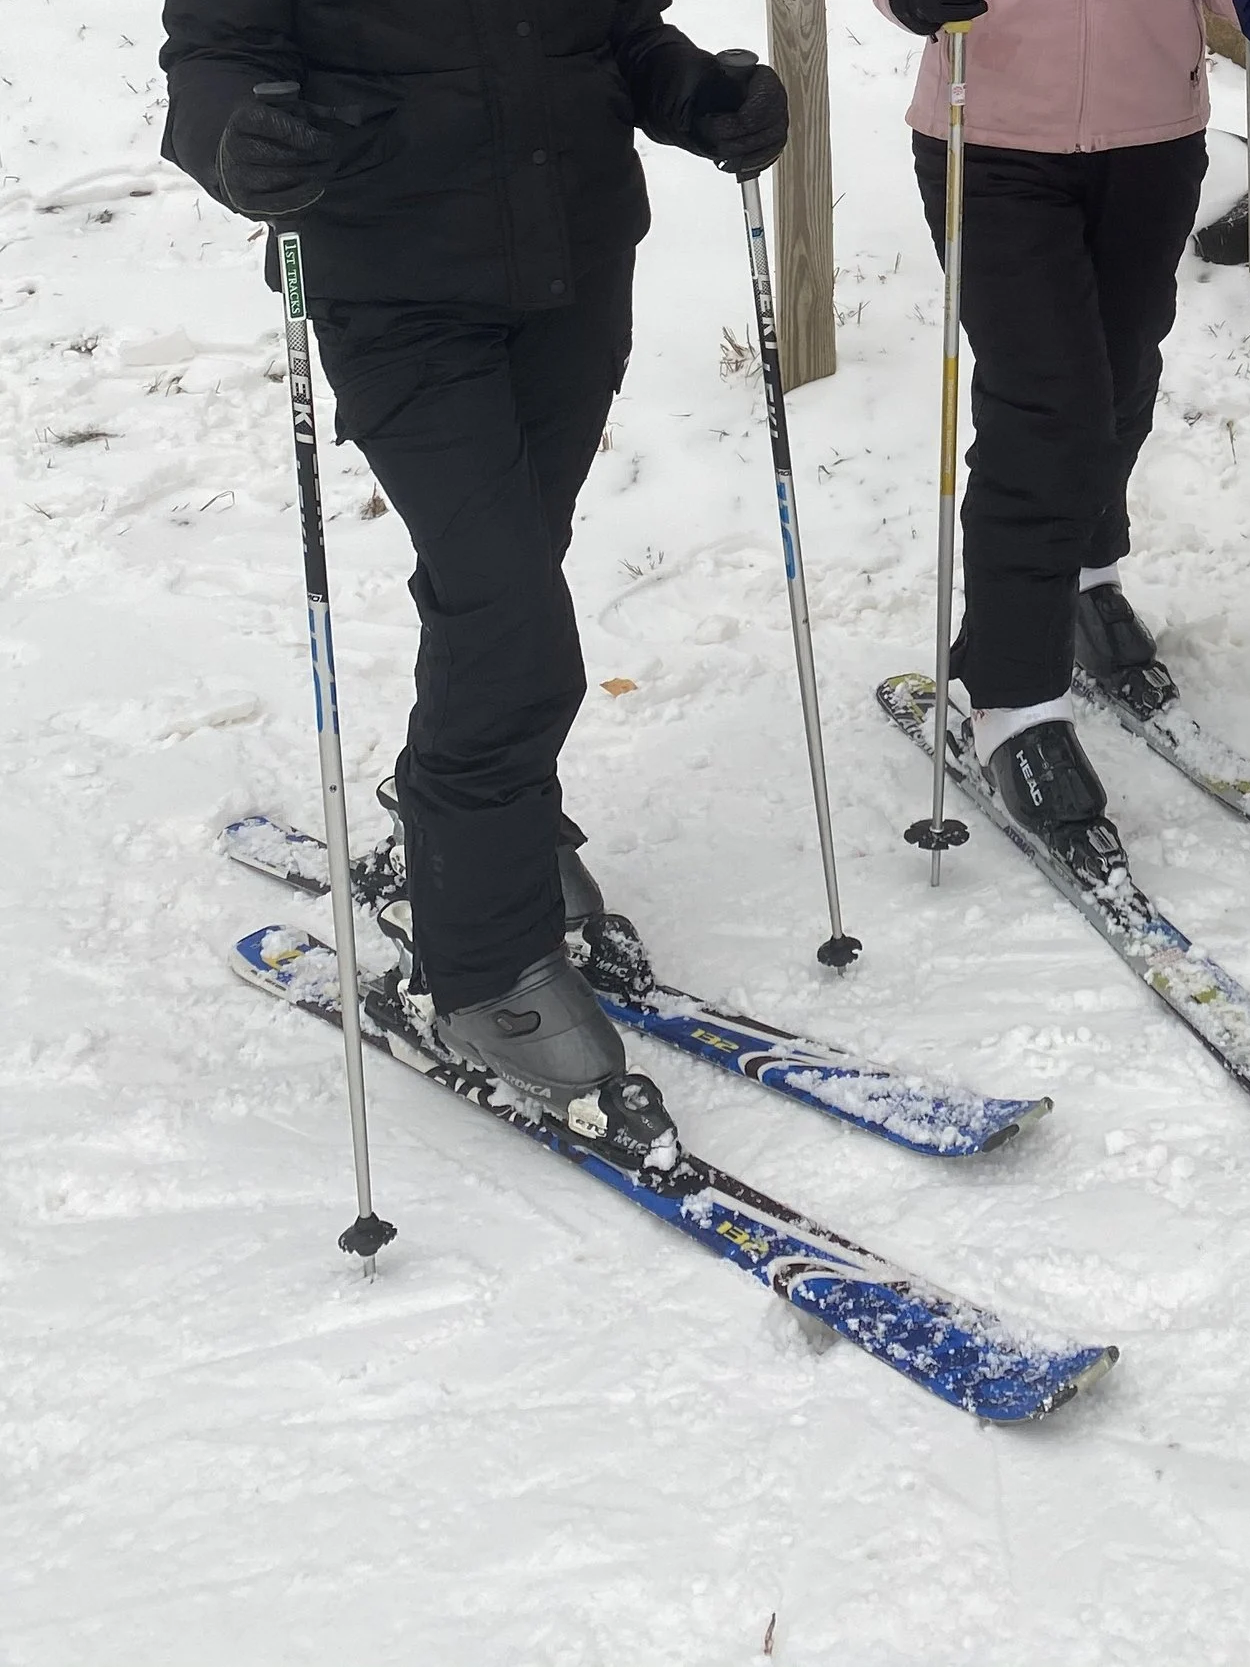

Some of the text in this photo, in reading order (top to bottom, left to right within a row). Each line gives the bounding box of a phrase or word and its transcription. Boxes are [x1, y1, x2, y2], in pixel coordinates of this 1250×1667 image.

[288, 268, 301, 315] TRACKS
[289, 348, 314, 445] LEKI
[1015, 749, 1043, 807] HEAD
[690, 1028, 740, 1053] 132
